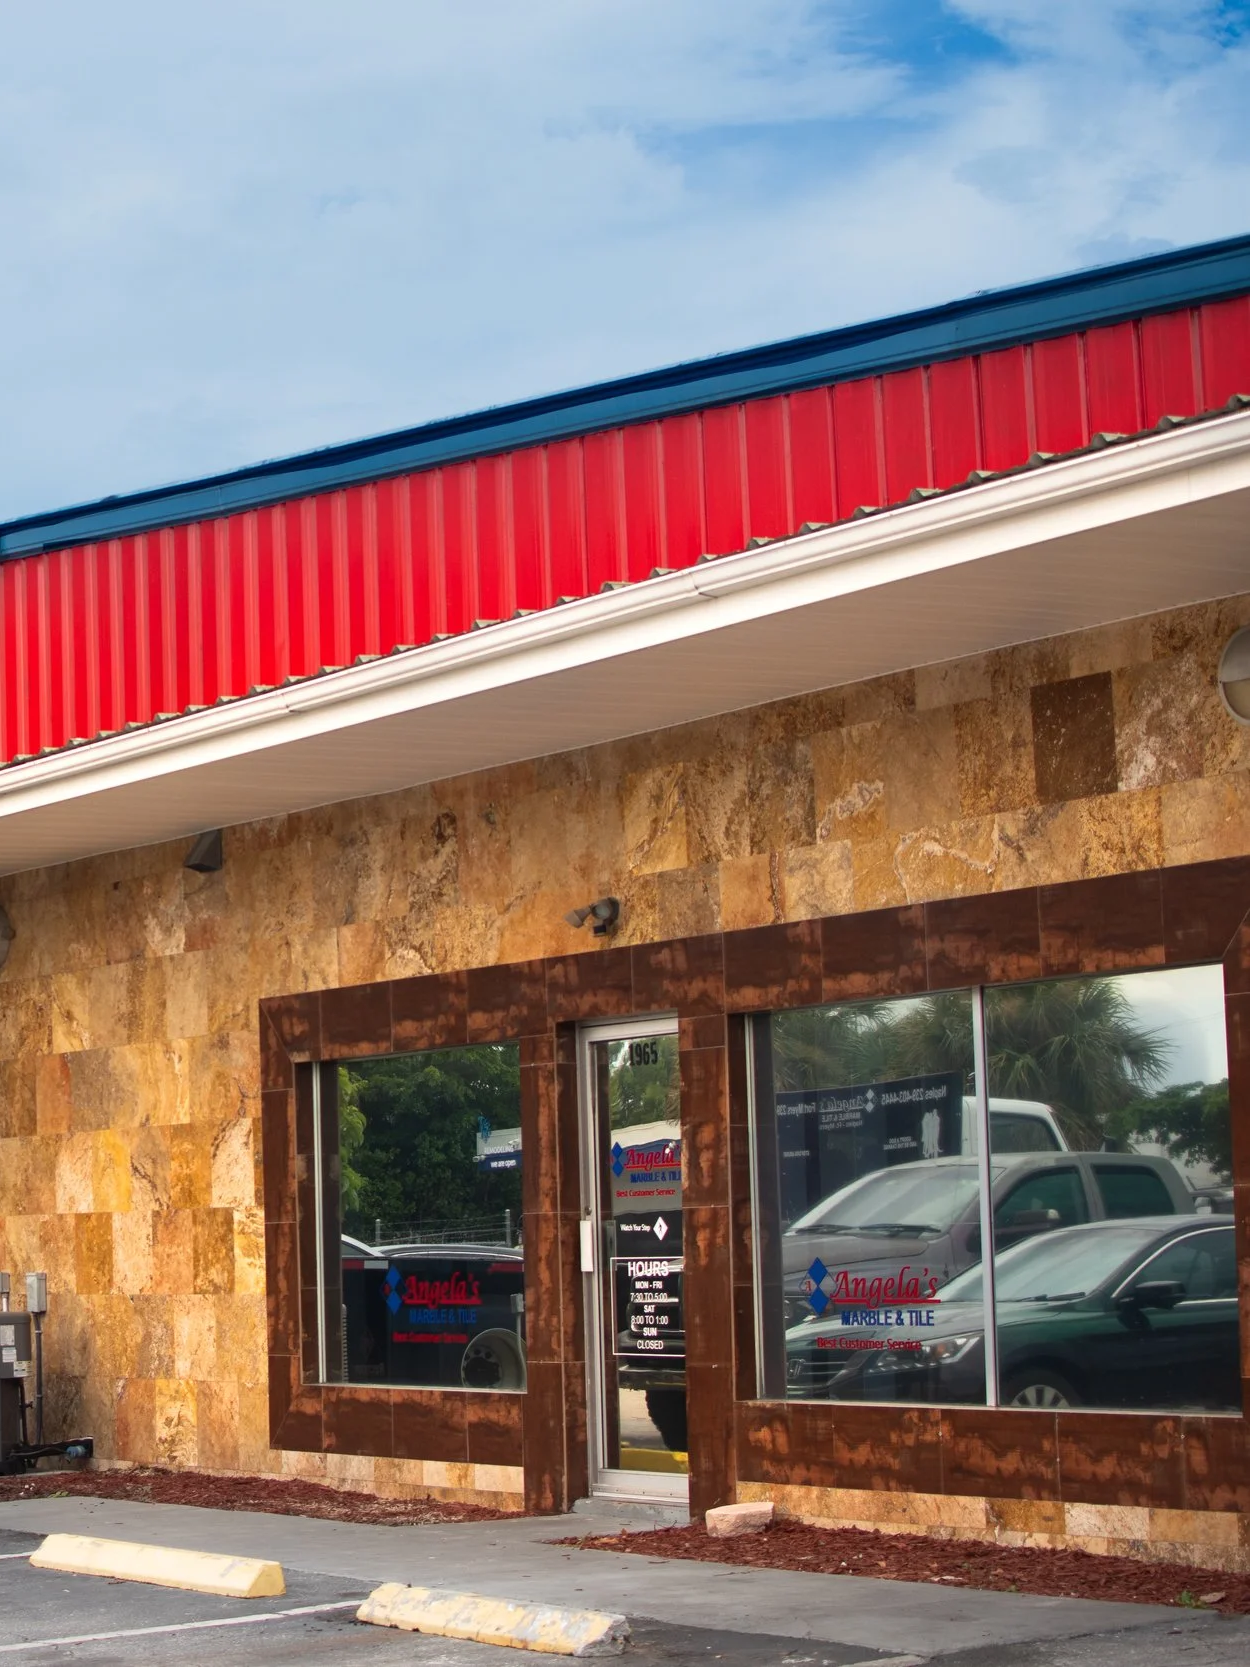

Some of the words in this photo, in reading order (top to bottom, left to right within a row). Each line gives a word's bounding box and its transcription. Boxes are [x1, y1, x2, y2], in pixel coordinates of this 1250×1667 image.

[628, 1041, 658, 1066] 1965
[624, 1143, 682, 1172] Angela'
[629, 1189, 655, 1197] Customer
[628, 1261, 669, 1276] HOURS
[402, 1271, 480, 1309] Angela's
[635, 1280, 649, 1289] MON
[652, 1280, 663, 1289] FRI
[830, 1266, 939, 1309] Angela's
[630, 1292, 643, 1302] 7:30
[644, 1292, 654, 1301] TO
[643, 1304, 655, 1313] SAT
[645, 1315, 654, 1324] TO
[655, 1315, 668, 1325] 1:00
[841, 1310, 893, 1326] MARBLE
[896, 1310, 905, 1326] &
[907, 1310, 935, 1326] TILE
[642, 1327, 657, 1336] SUN
[636, 1340, 664, 1350] CLOSED
[817, 1336, 837, 1349] Best
[839, 1337, 884, 1349] Customer
[887, 1338, 922, 1351] Service
